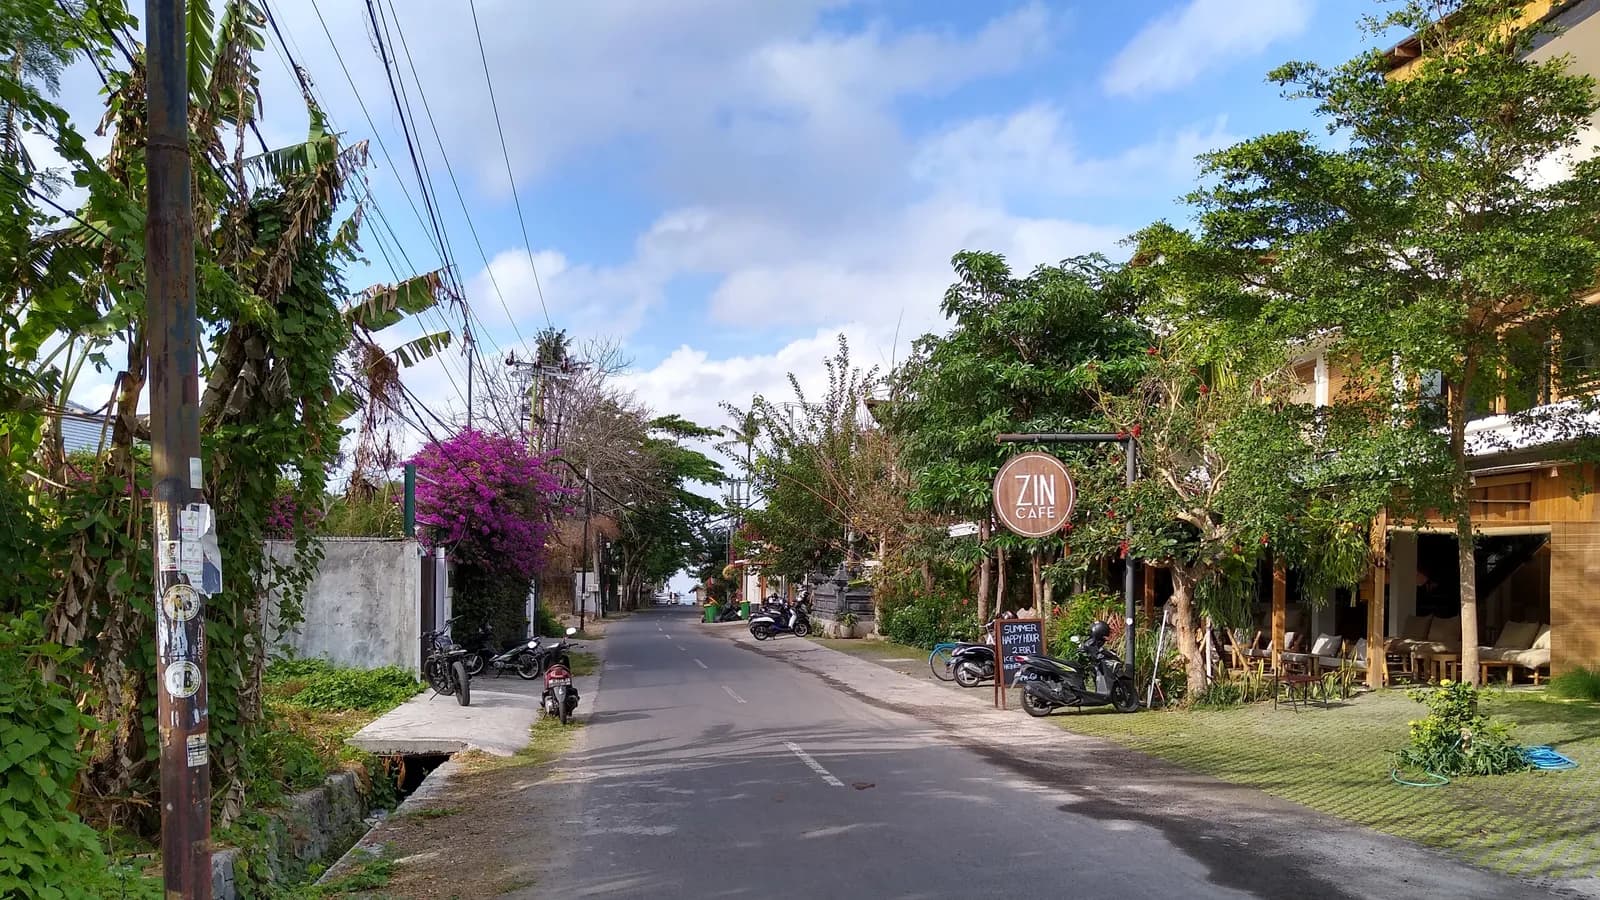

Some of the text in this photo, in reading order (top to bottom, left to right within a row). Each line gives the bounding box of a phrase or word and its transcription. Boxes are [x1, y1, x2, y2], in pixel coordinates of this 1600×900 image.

[1014, 474, 1055, 506] ZIN
[1015, 506, 1055, 519] CAFE
[1004, 624, 1037, 634] SUMMER
[1002, 633, 1040, 644] HAPPY HOUR
[1012, 646, 1018, 654] 2
[1032, 644, 1037, 654] 1
